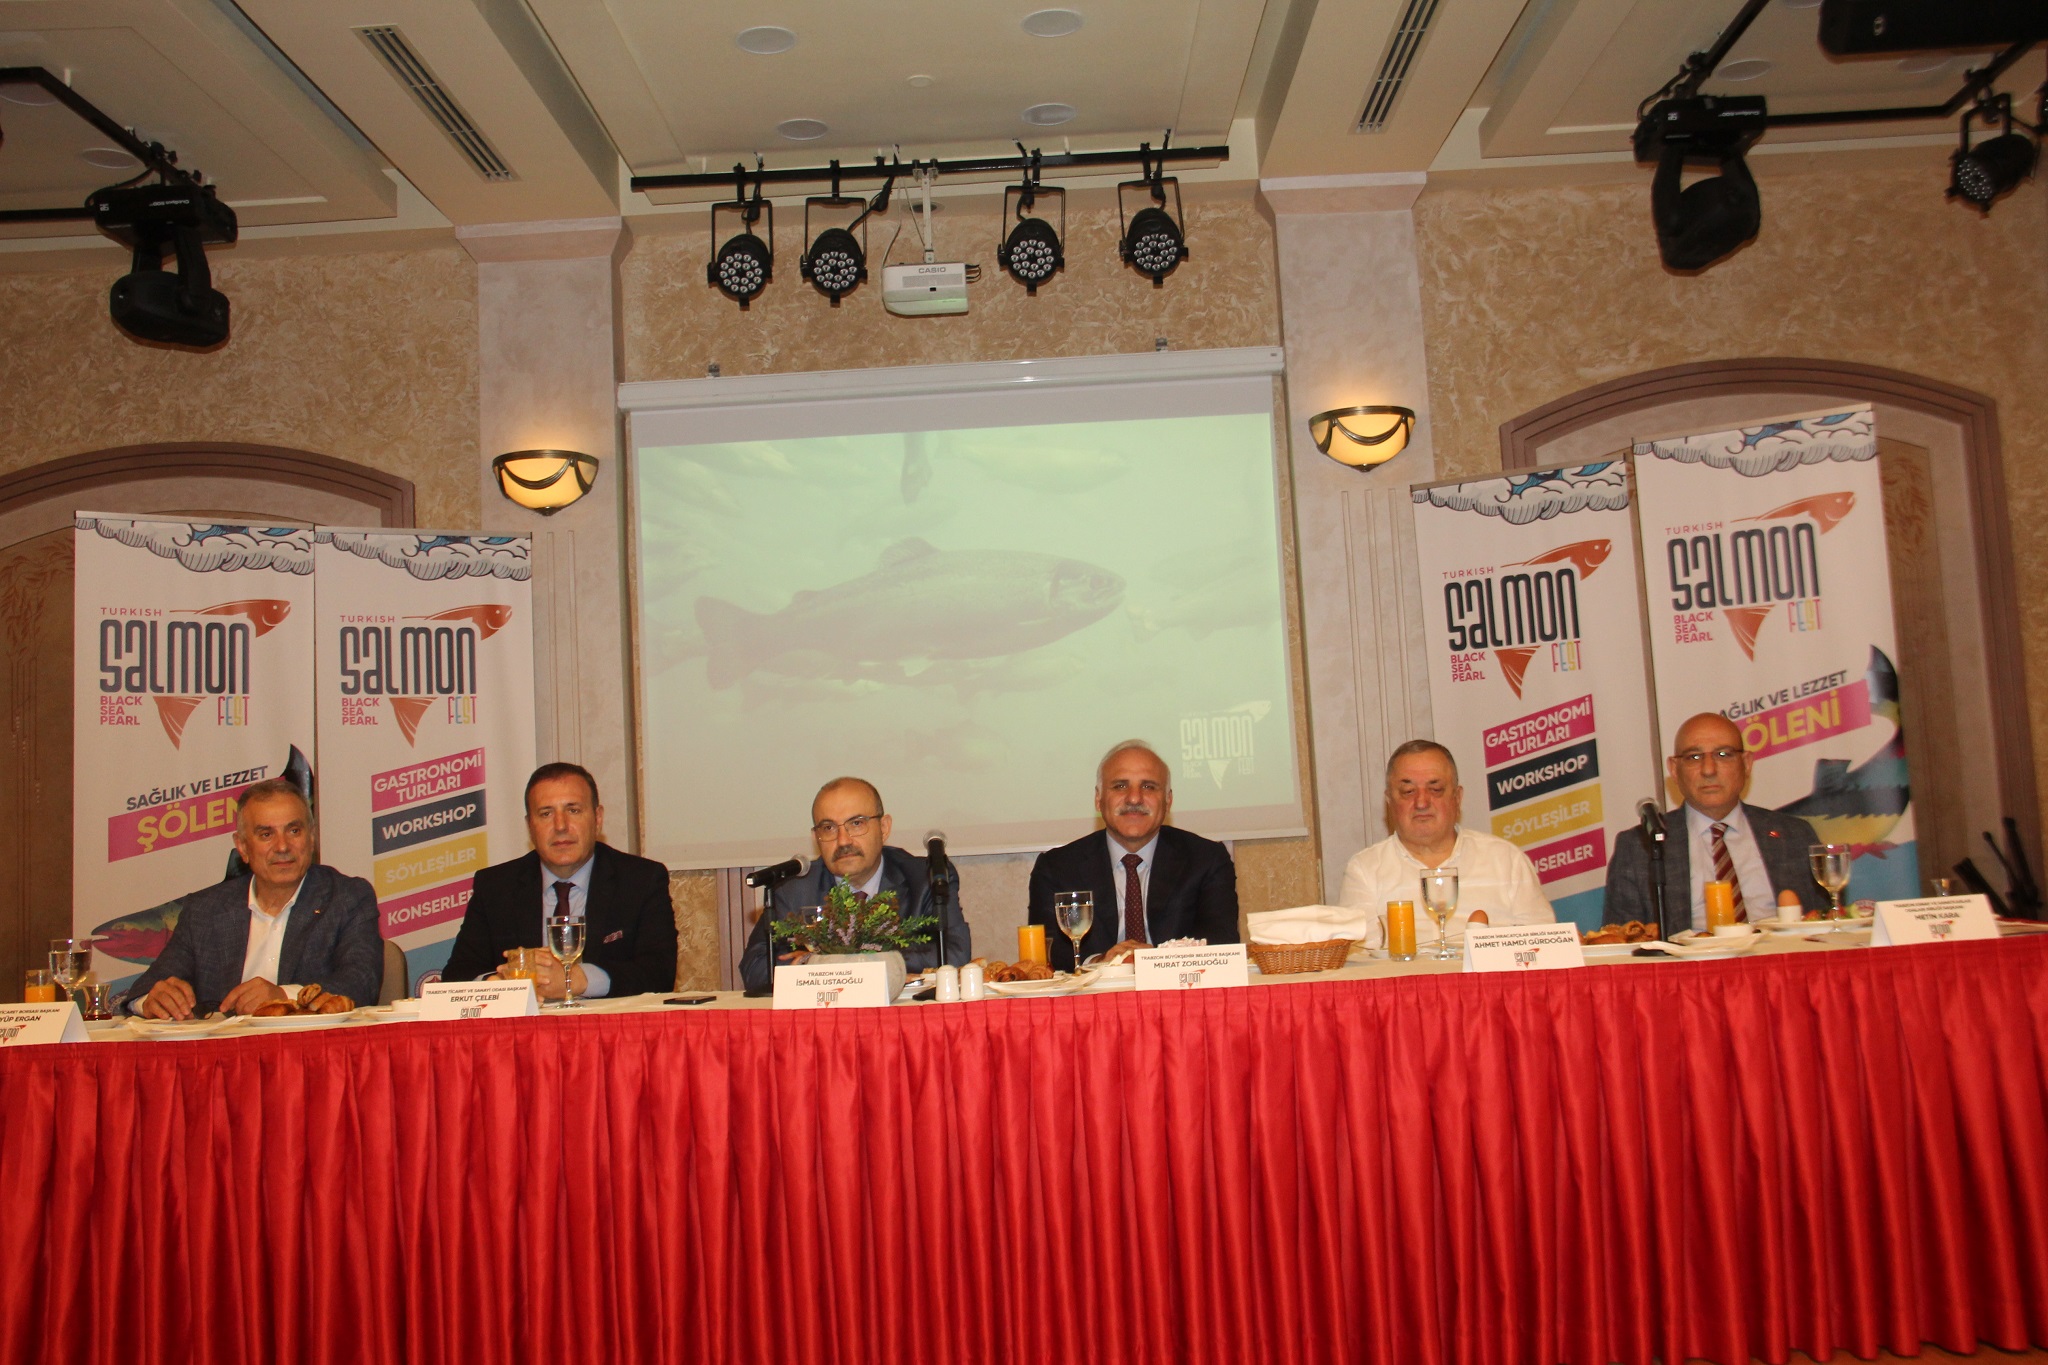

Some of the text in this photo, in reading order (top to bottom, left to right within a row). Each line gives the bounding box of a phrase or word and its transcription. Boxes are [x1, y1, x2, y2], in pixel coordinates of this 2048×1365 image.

[918, 266, 946, 274] CASIO
[1665, 521, 1724, 536] TURKISH
[1442, 566, 1494, 580] TURKISH
[100, 607, 162, 616] TURKISH
[1673, 611, 1714, 625] BLACK
[1788, 598, 1822, 632] FEST
[340, 615, 395, 623] TURKISH
[1674, 623, 1698, 635] SEA
[1675, 632, 1714, 644] PEARL
[1450, 652, 1486, 664] BLACK
[1551, 640, 1582, 672] FEST
[1451, 662, 1472, 674] SEA
[1452, 672, 1486, 683] PEARL
[100, 696, 143, 706] BLACK
[1718, 669, 1848, 720] AĞLIK VE LEZZET
[342, 698, 380, 707] BLACK
[100, 706, 125, 716] SEA
[217, 696, 250, 726] FEST
[342, 707, 364, 716] SEA
[448, 696, 477, 725] FEST
[100, 716, 140, 726] PEARL
[342, 716, 378, 726] PEARL
[1486, 696, 1591, 748] GASTRONOMİ
[1742, 689, 1842, 753] ÖLENİ
[1507, 724, 1570, 757] TURLARI
[374, 750, 482, 792] GASTRONOMİ
[1496, 754, 1588, 796] WORKSHOP
[126, 765, 268, 811] SAĞLIK VE LEZZET
[396, 774, 461, 802] TURLARI
[136, 796, 239, 853] ŞÖLEN
[382, 803, 476, 840] WORKSHOP
[1502, 800, 1590, 840] SÖYLEŞİLER
[384, 847, 477, 884] SÖYLEŞİLER
[1534, 844, 1594, 874] SERLER
[1502, 938, 1527, 947] HAMDİ
[1529, 936, 1574, 946] GÜRDOĞAN
[1182, 958, 1228, 967] ZORLUOĞLU
[796, 976, 863, 987] İSMAİL USTAOĞLU
[474, 993, 500, 1003] ÇELEBİ
